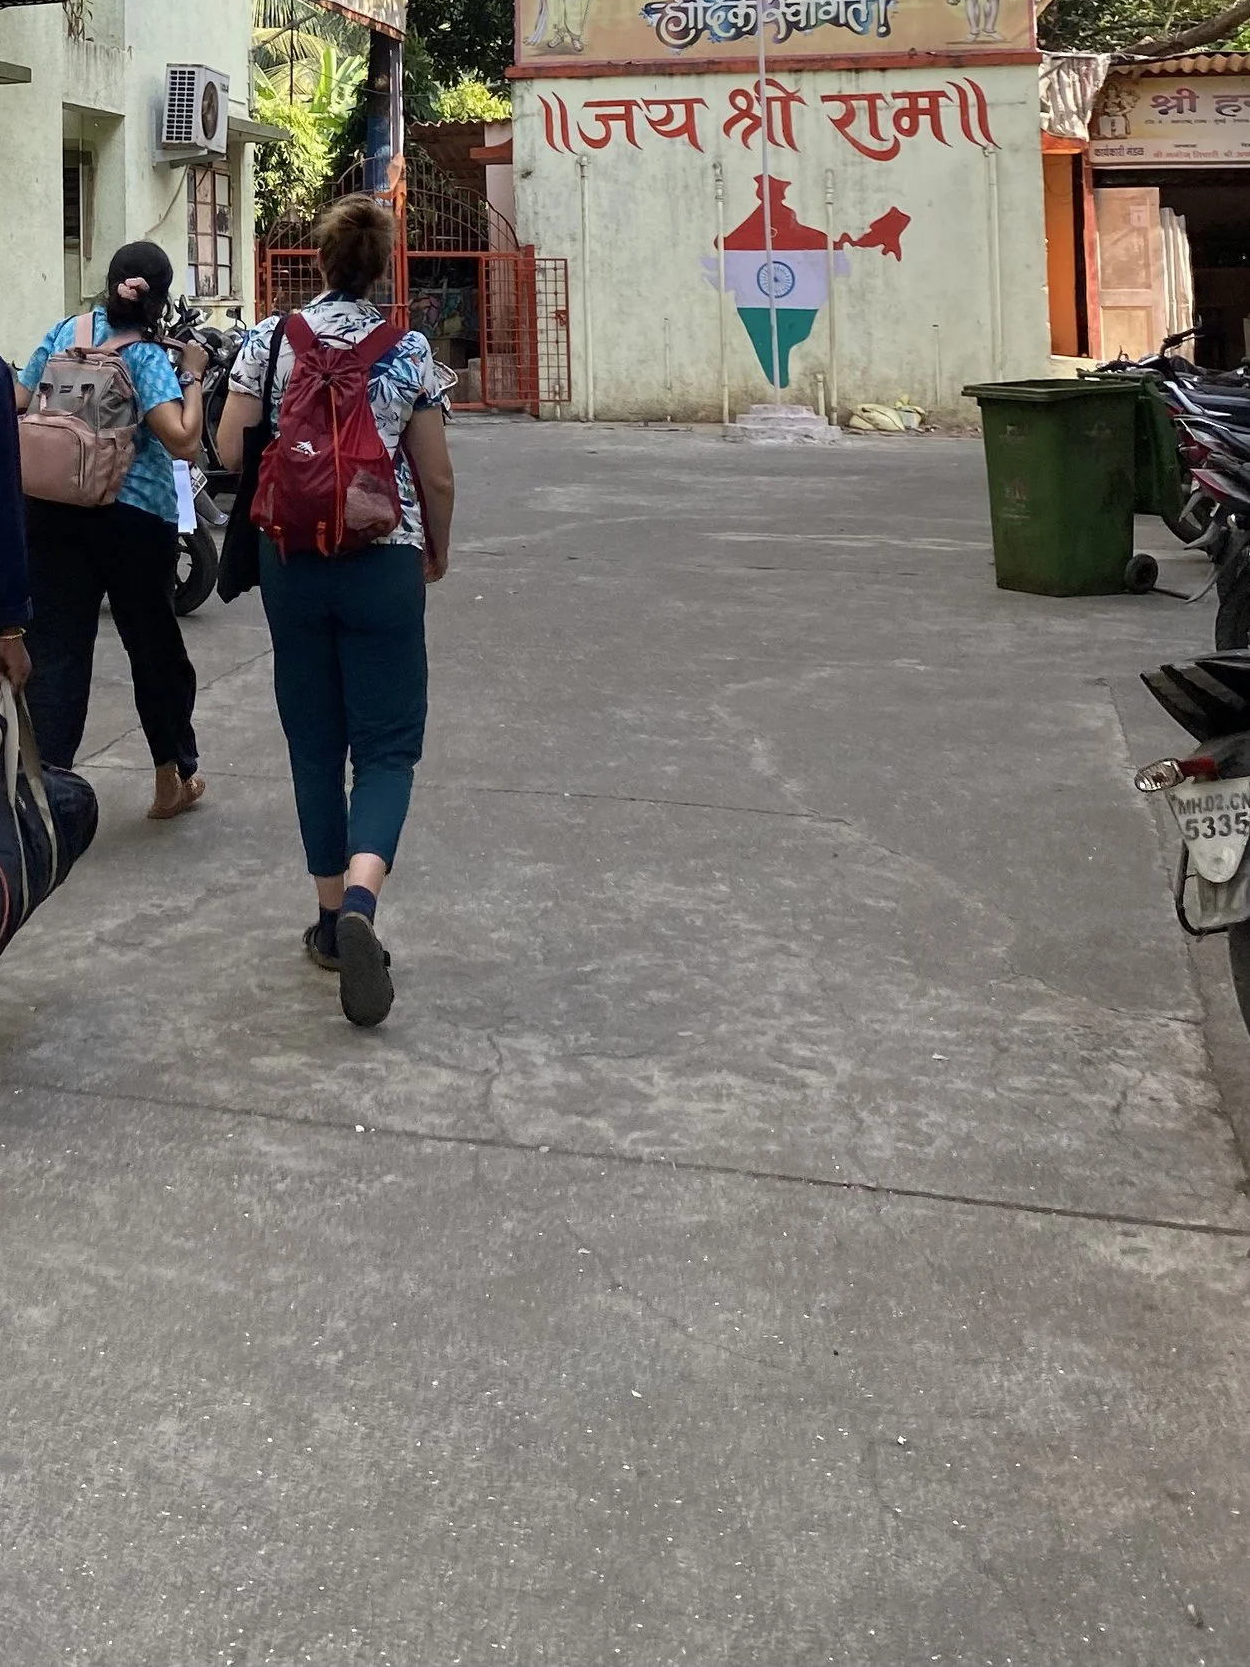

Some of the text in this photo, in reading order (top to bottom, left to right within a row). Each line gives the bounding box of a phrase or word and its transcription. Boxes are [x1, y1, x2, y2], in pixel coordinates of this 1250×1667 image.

[723, 78, 810, 154] श्री
[1150, 87, 1200, 116] श्री
[1184, 811, 1250, 841] 5335
